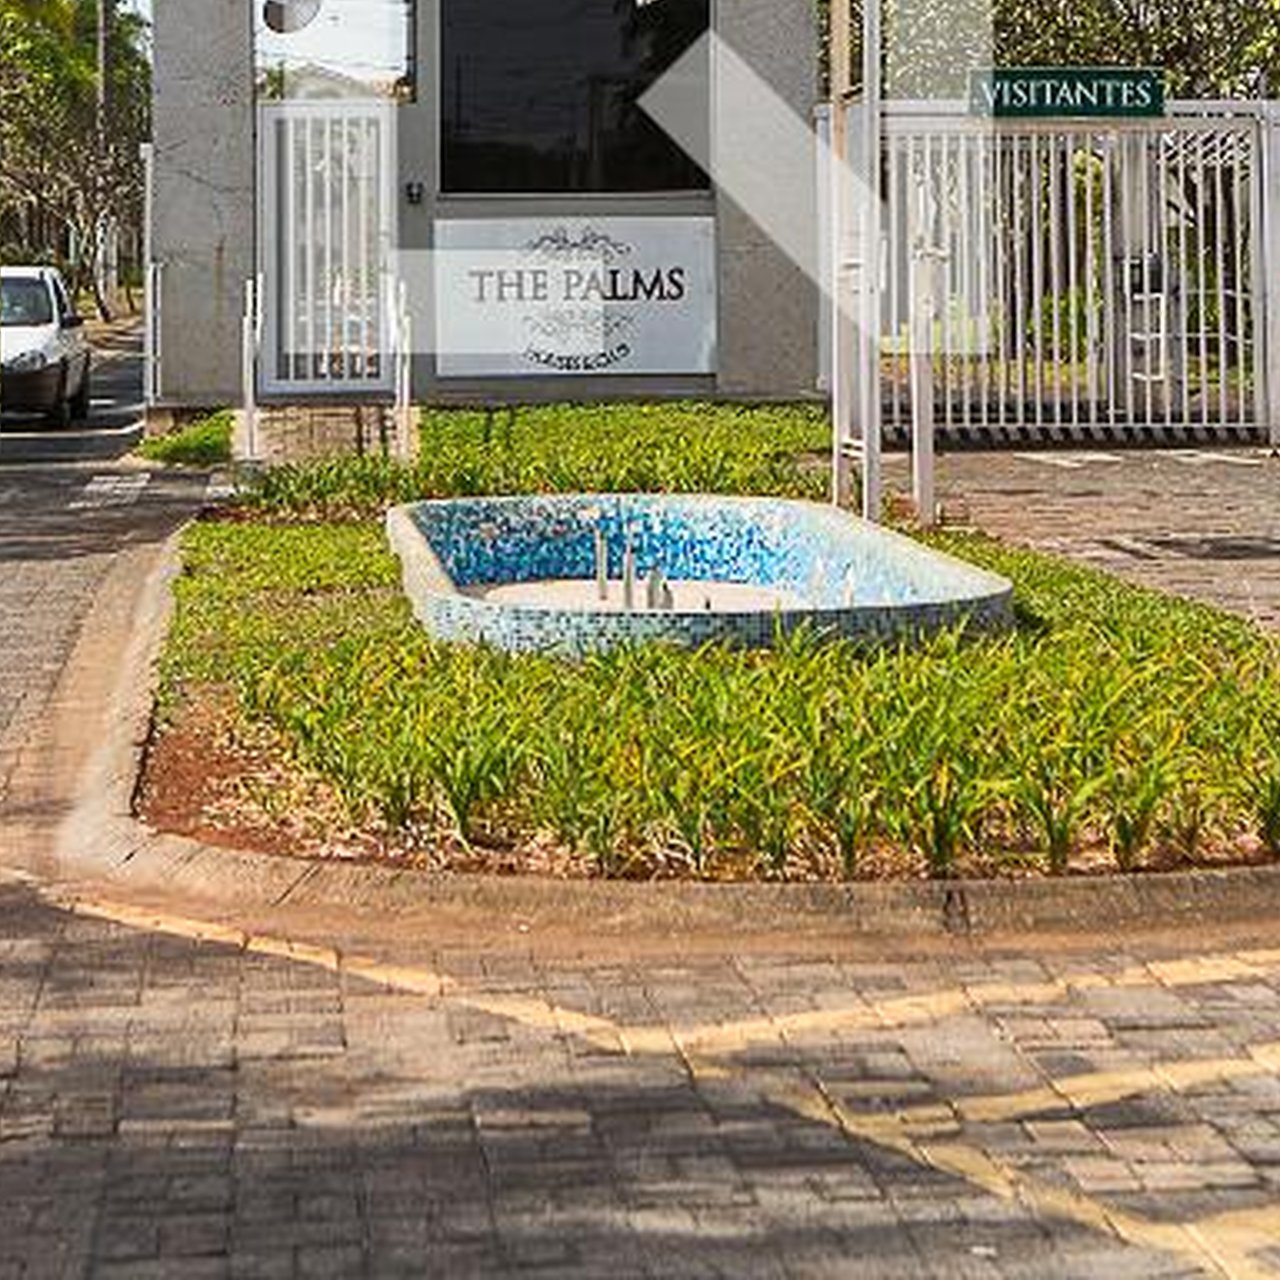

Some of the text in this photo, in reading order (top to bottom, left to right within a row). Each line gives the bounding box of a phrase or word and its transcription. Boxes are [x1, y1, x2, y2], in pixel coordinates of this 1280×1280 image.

[981, 80, 1152, 107] VISITANTES
[469, 268, 686, 302] THE PALMS
